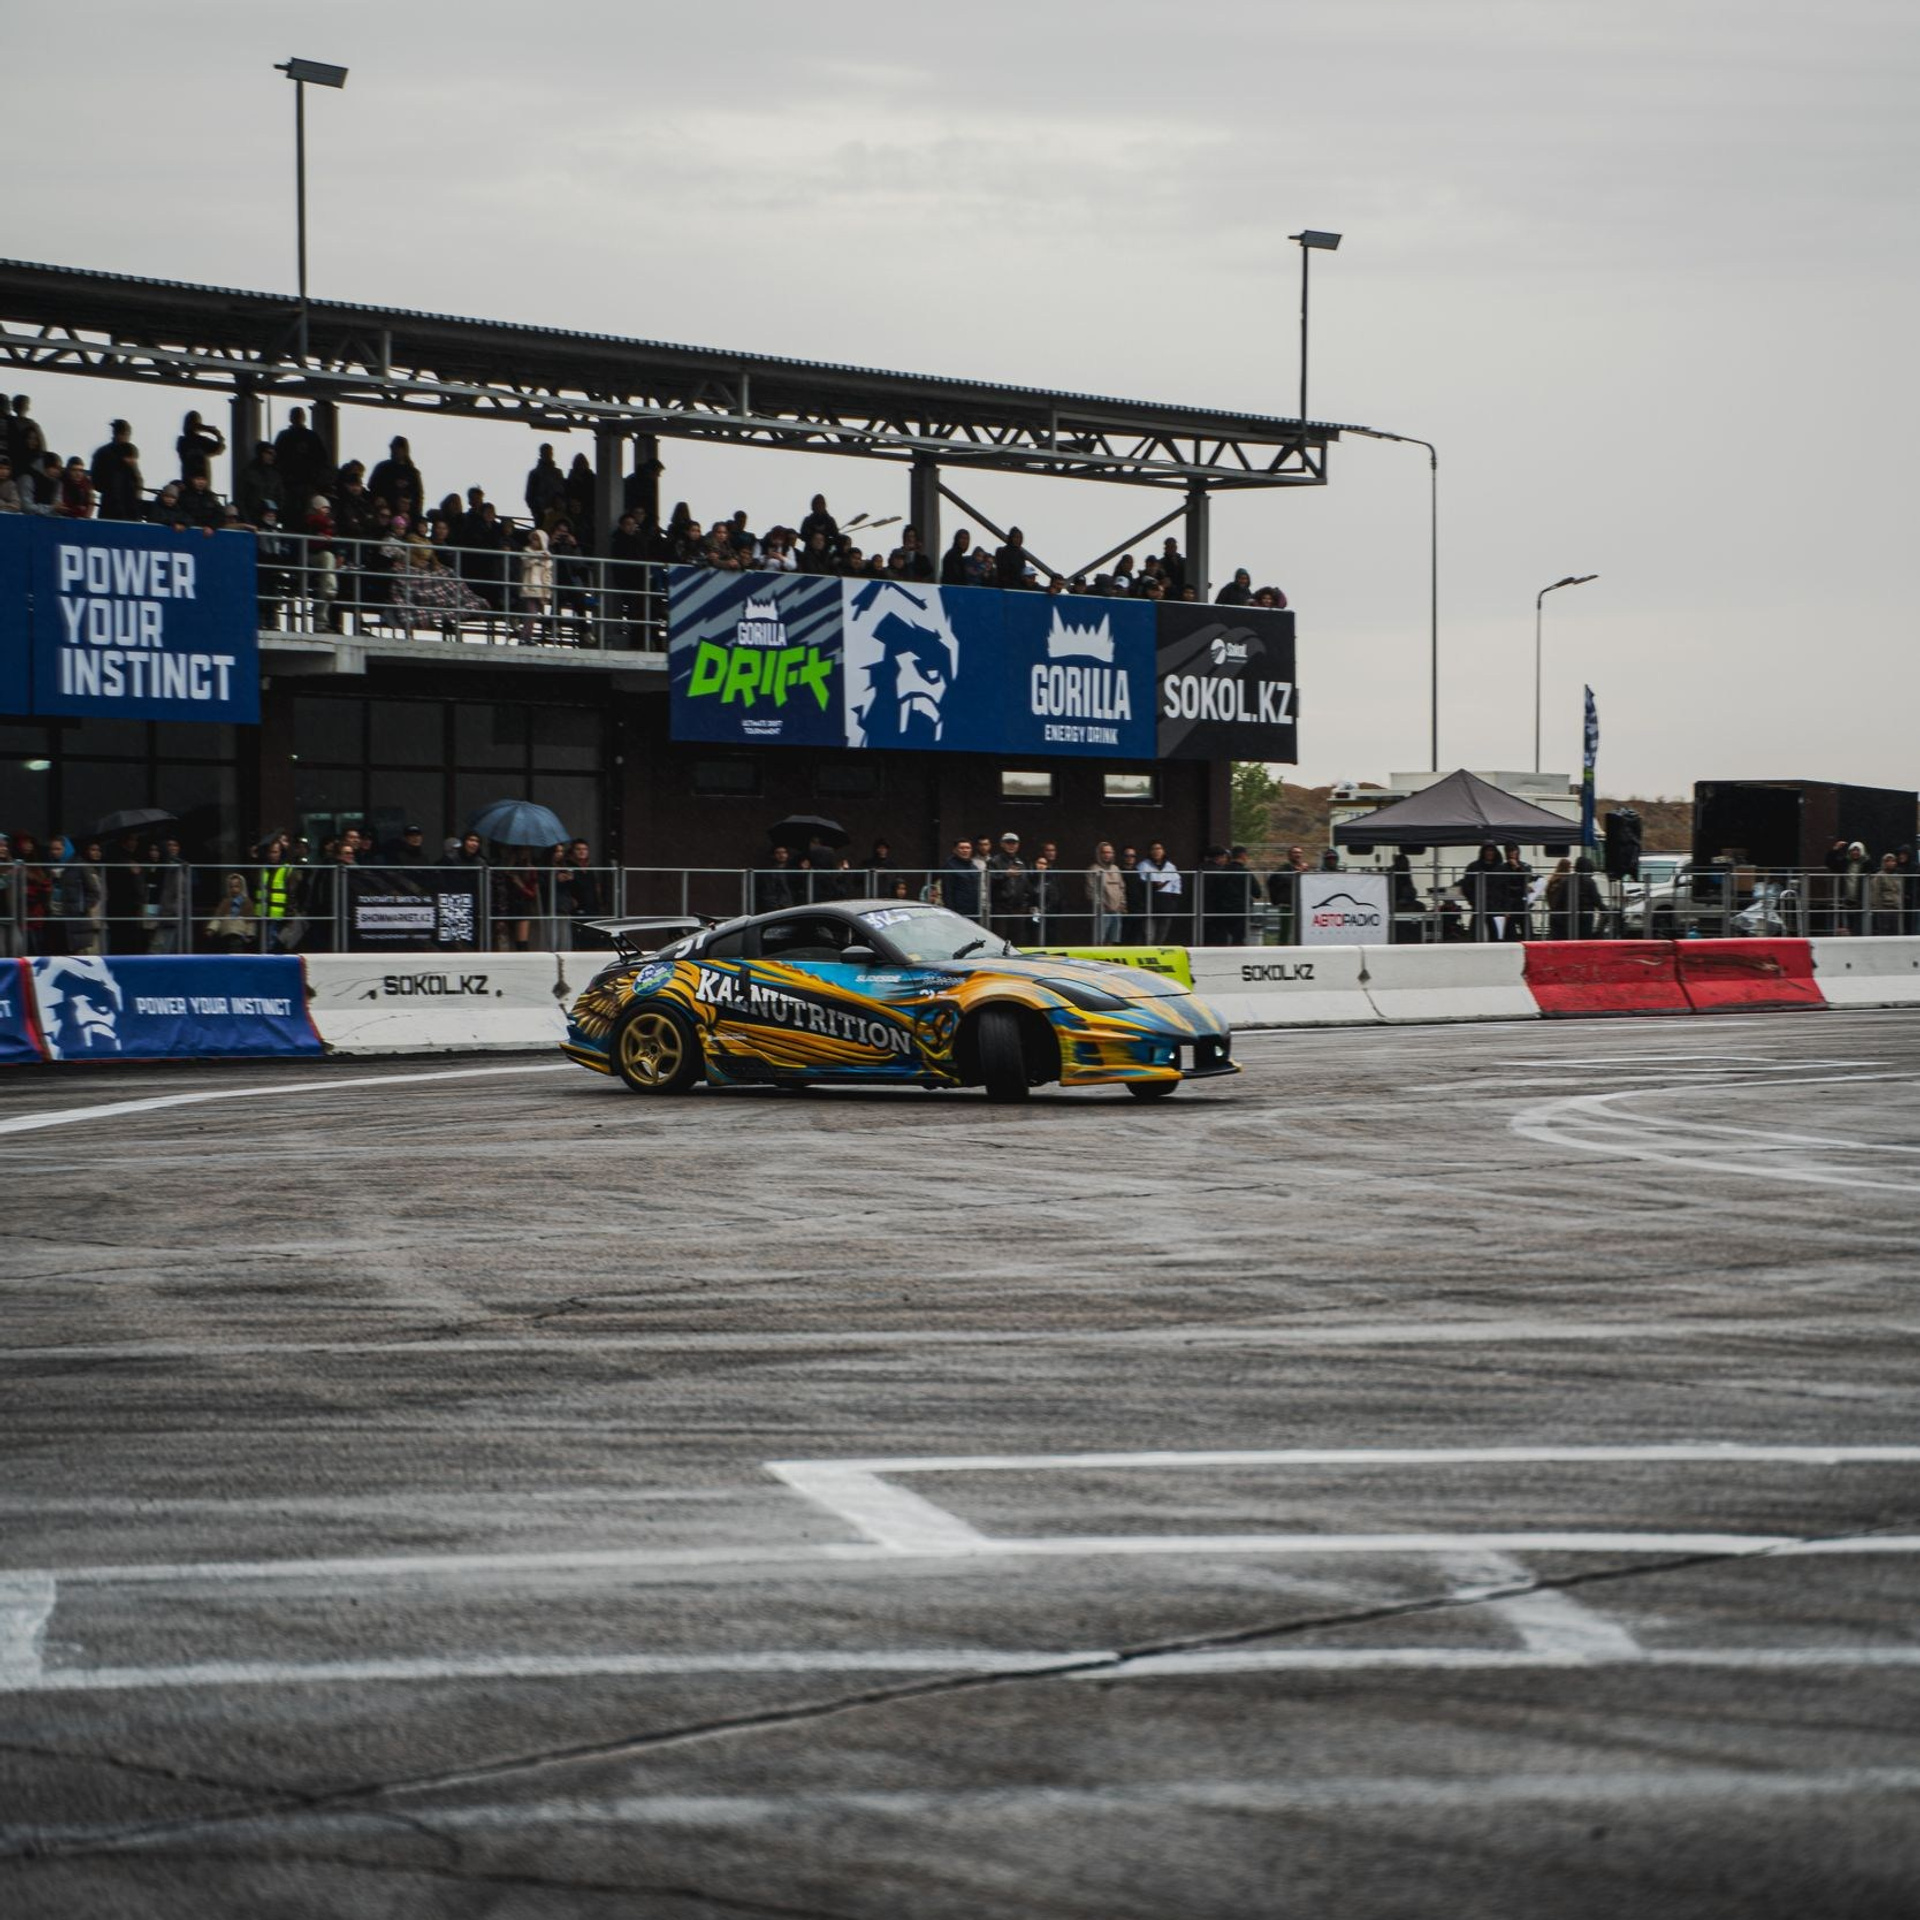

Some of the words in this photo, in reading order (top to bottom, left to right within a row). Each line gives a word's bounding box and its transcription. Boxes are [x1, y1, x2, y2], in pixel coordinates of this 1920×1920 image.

[59, 544, 196, 599] POWER
[58, 596, 164, 648] YOUR
[737, 621, 787, 646] GORILLA
[60, 647, 235, 701] INSTINCT
[686, 639, 833, 712] DRIFT
[1031, 664, 1132, 721] GORILLA
[1163, 674, 1293, 725] SOKOL.KZ
[1044, 724, 1086, 743] ENERGY
[1086, 727, 1119, 745] DRINK
[135, 997, 187, 1014] POWER
[190, 997, 229, 1015] YOUR
[231, 998, 291, 1016] INSTINCT
[384, 975, 489, 995] SOKOL.KZ
[750, 983, 911, 1055] NUTRITION
